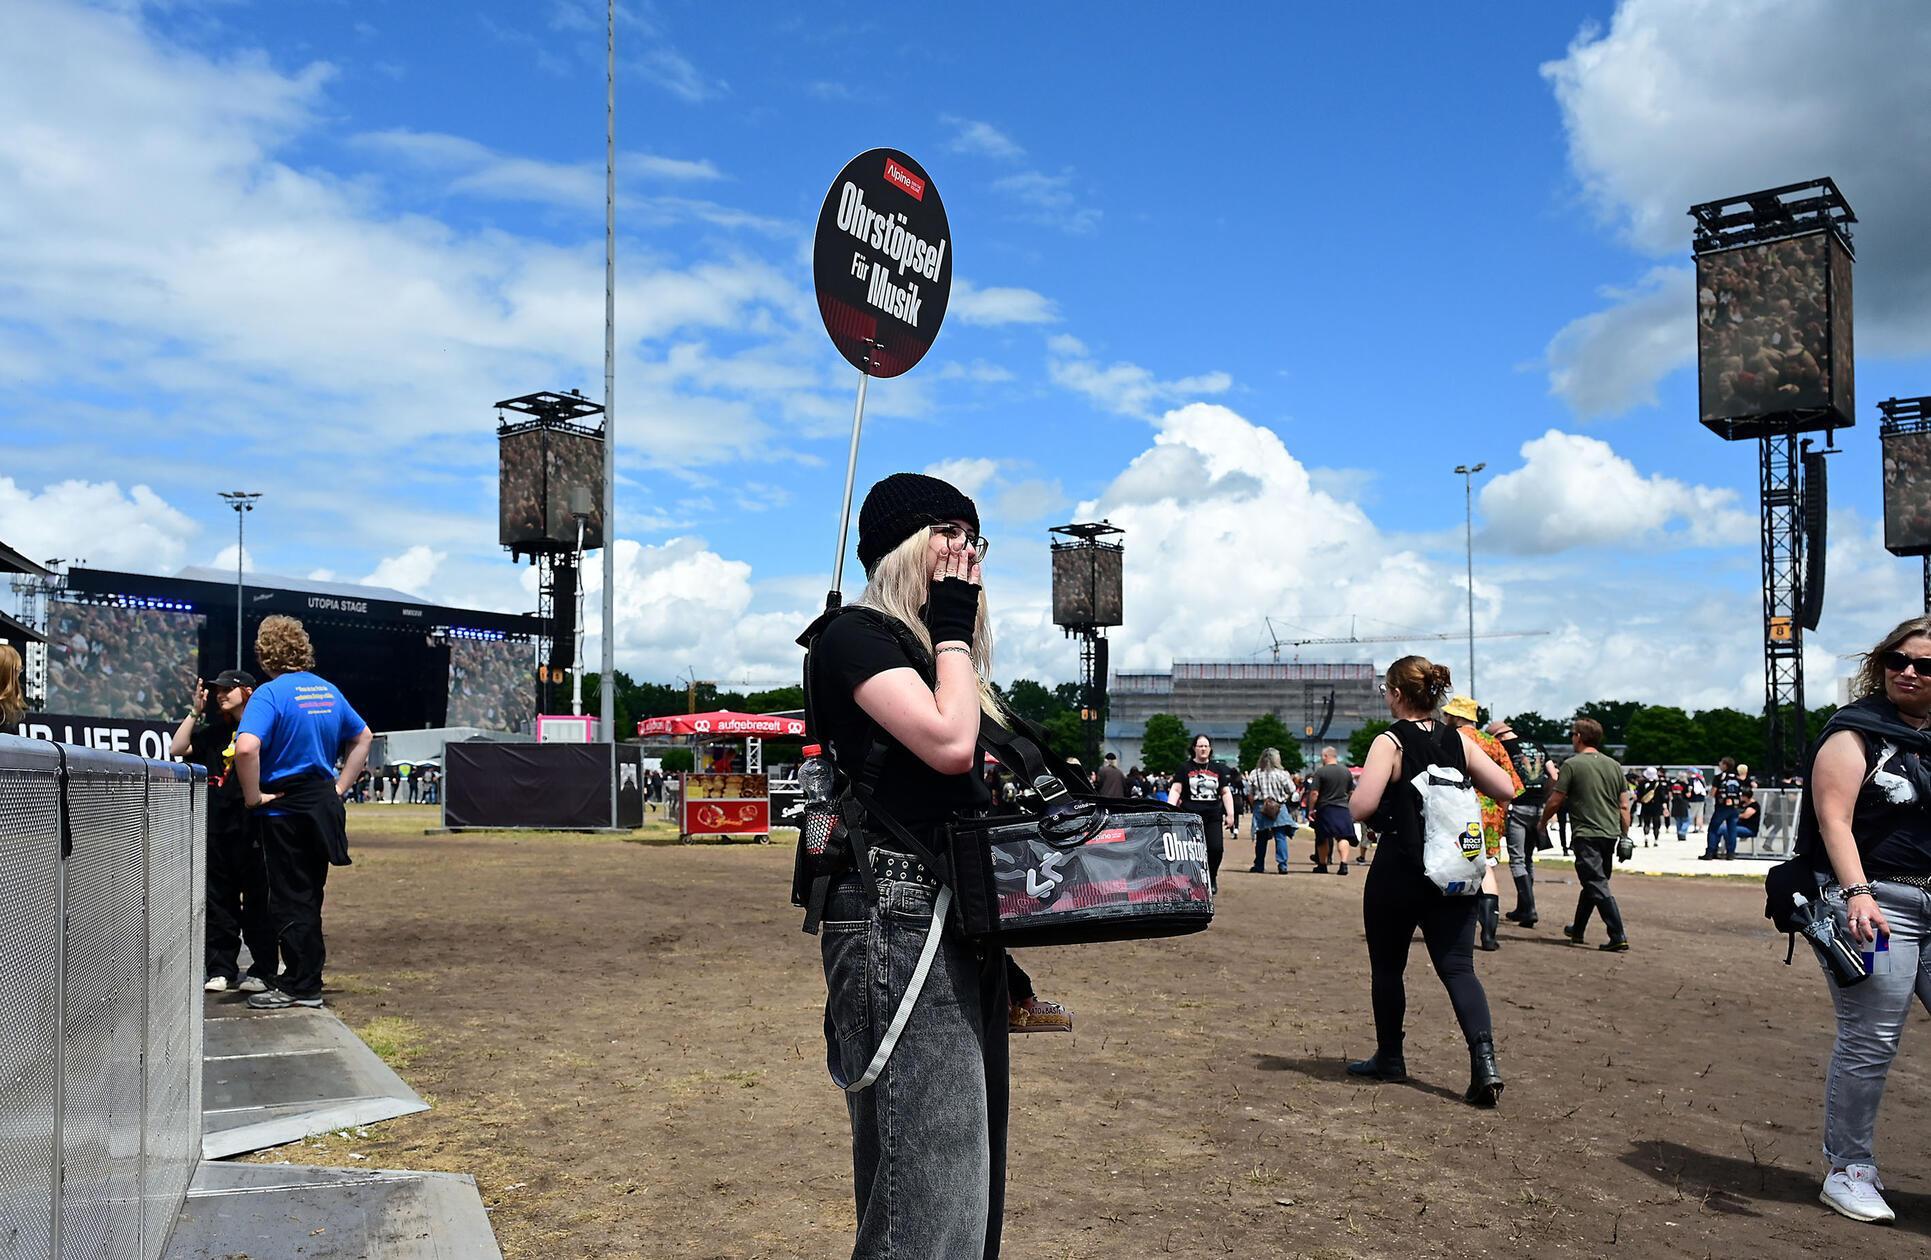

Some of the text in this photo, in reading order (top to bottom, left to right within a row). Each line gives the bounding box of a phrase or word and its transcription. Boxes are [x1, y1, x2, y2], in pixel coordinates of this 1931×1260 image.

[887, 164, 911, 187] Alpine
[836, 180, 946, 284] Ohrstöpsel
[850, 251, 923, 328] Für Musik
[308, 597, 367, 613] UTOPIA STAGE
[1776, 626, 1784, 636] 8
[718, 719, 781, 732] aufgebrezelt
